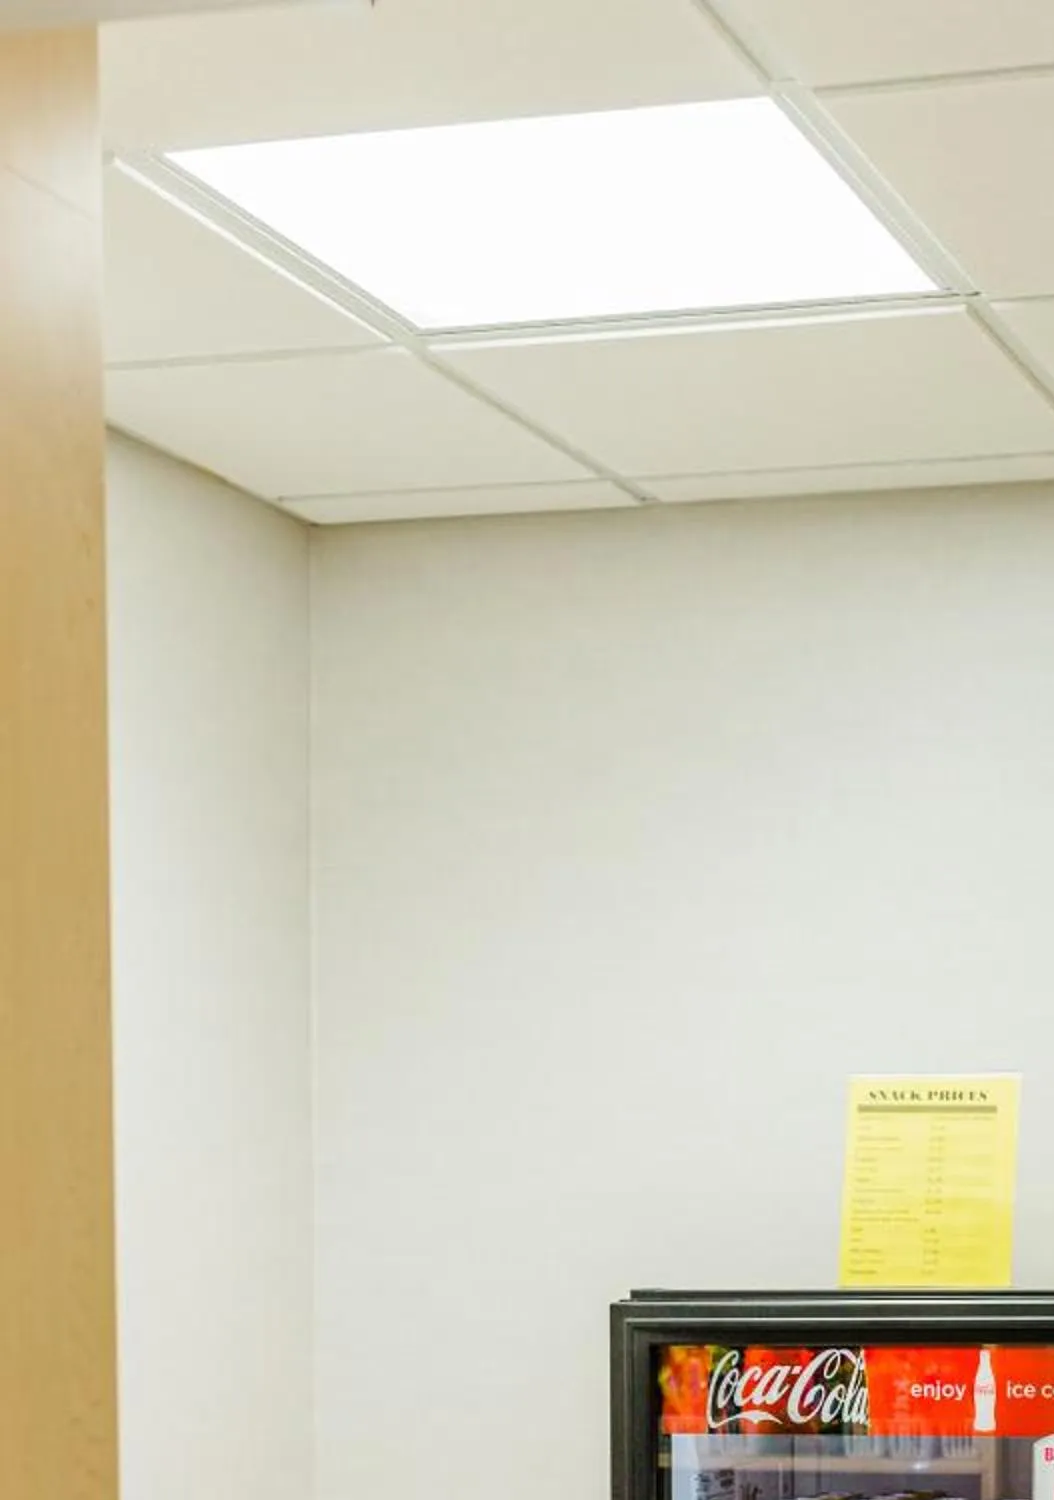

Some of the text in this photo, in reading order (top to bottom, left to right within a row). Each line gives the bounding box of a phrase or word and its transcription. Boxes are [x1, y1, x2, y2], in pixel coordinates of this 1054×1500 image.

[706, 1349, 869, 1429] Coca-Cola
[911, 1380, 967, 1401] enjoy
[1007, 1380, 1036, 1399] ice
